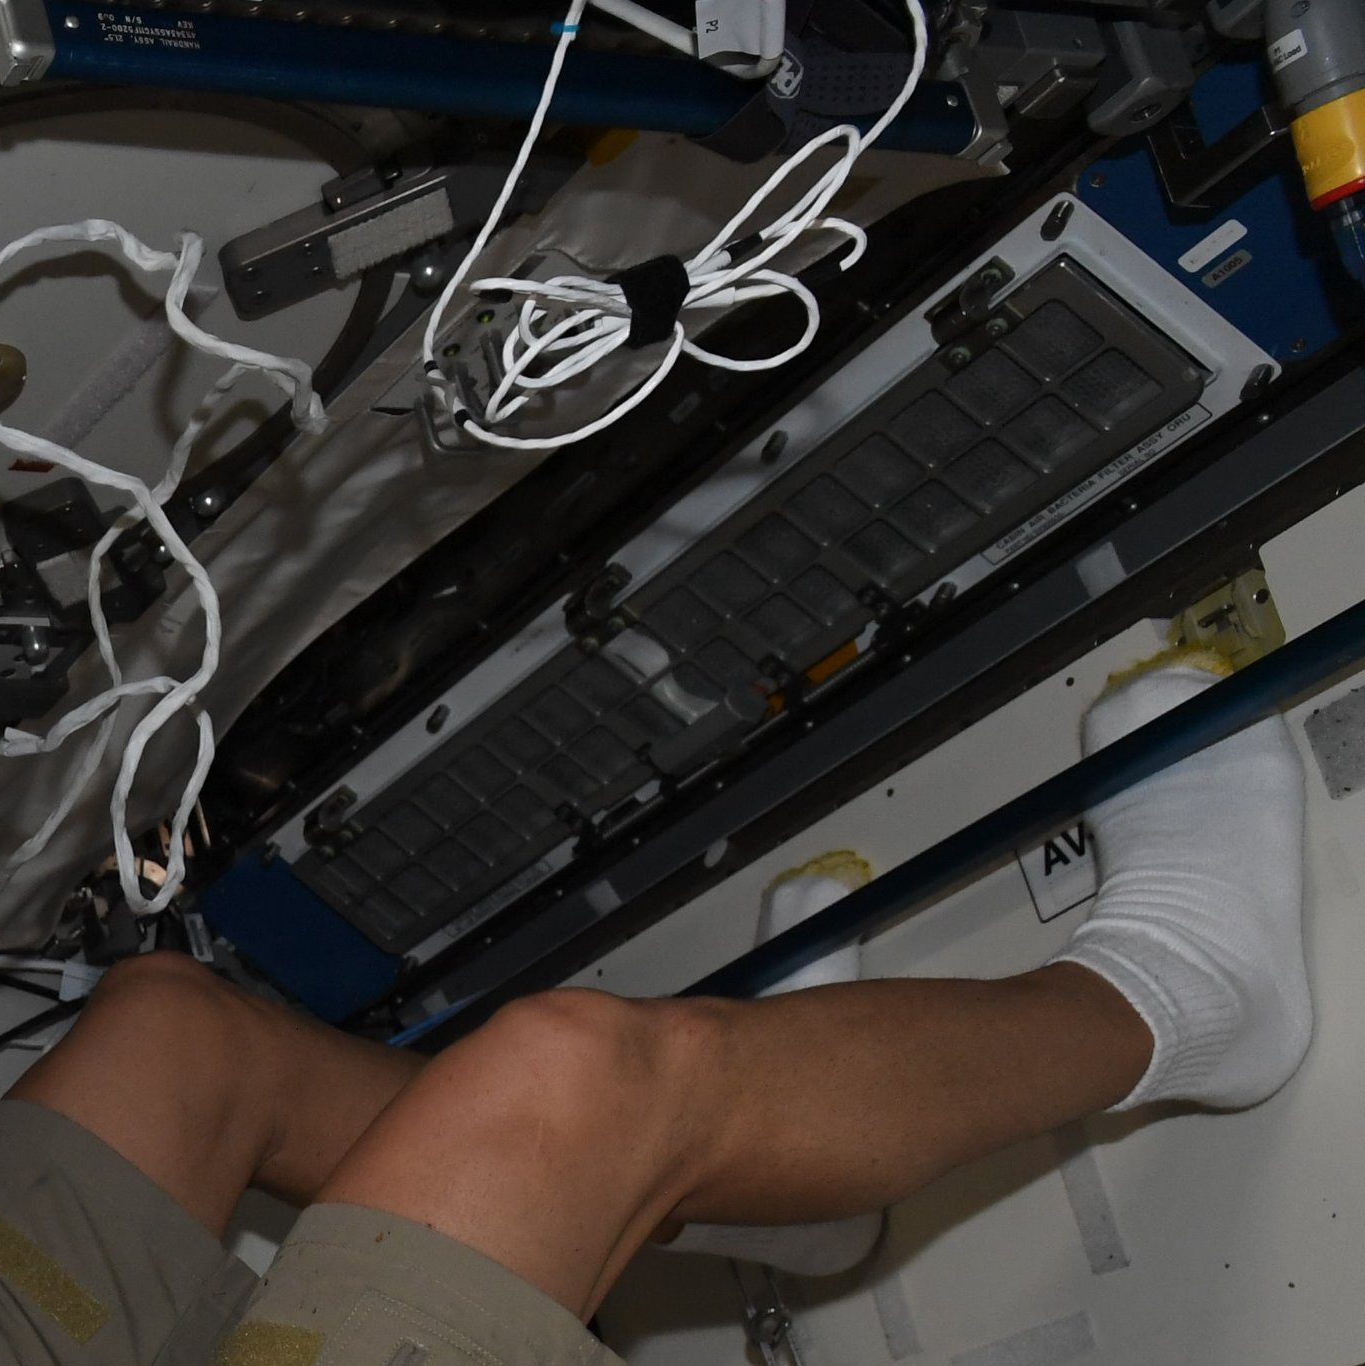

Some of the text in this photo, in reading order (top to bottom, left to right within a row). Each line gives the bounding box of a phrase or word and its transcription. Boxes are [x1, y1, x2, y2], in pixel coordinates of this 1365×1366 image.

[705, 19, 718, 33] P2
[158, 37, 200, 49] HANDRAIL
[1282, 44, 1301, 60] Load
[1211, 255, 1242, 281] A1005
[993, 524, 1027, 552] CABIN
[1025, 509, 1047, 530] AIR
[1045, 474, 1099, 516] BACTERIA
[1095, 449, 1135, 482] FILTER
[1133, 428, 1165, 455] ASSY
[1164, 409, 1193, 434] ORU
